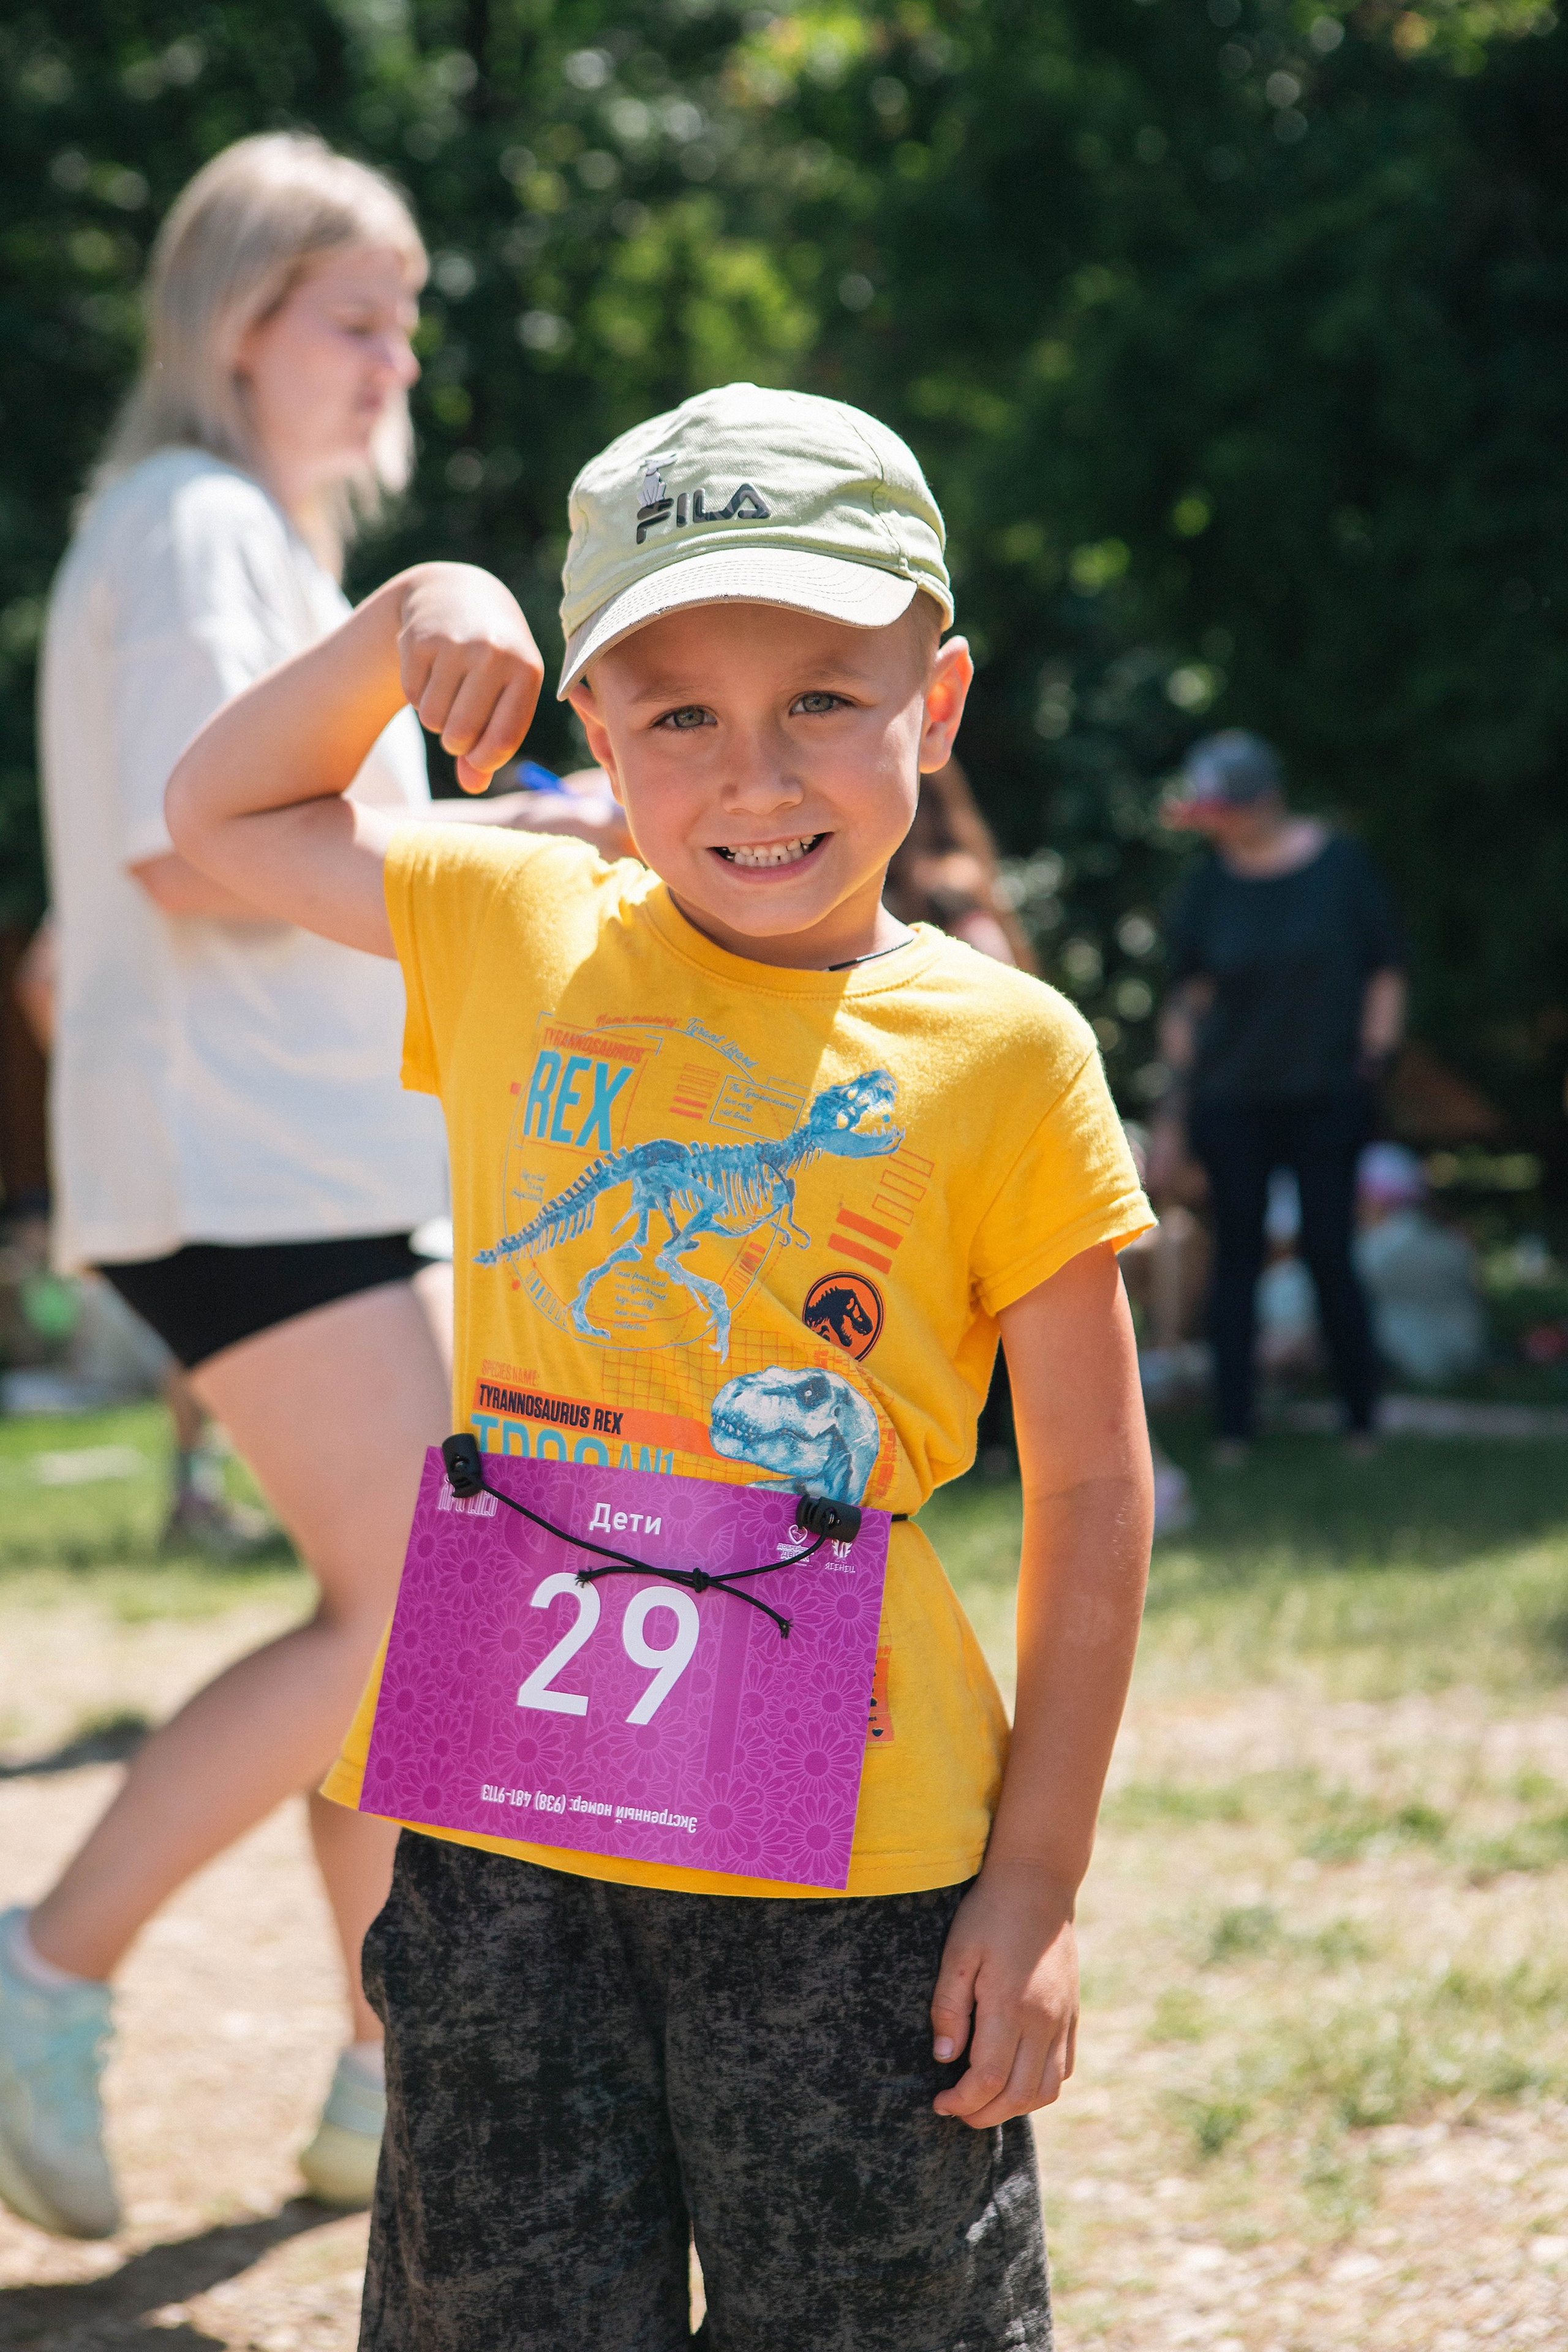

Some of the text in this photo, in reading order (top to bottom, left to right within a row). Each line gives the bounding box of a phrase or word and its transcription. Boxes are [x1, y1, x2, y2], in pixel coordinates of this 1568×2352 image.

[636, 483, 771, 545] FILA
[523, 1050, 635, 1152] REX
[480, 1384, 624, 1434] TYRANNOSAURUS REX
[589, 1502, 662, 1535] Дети
[517, 1572, 699, 1725] 29
[481, 1784, 698, 1833] Экстренный номер: (938) 481-9113
